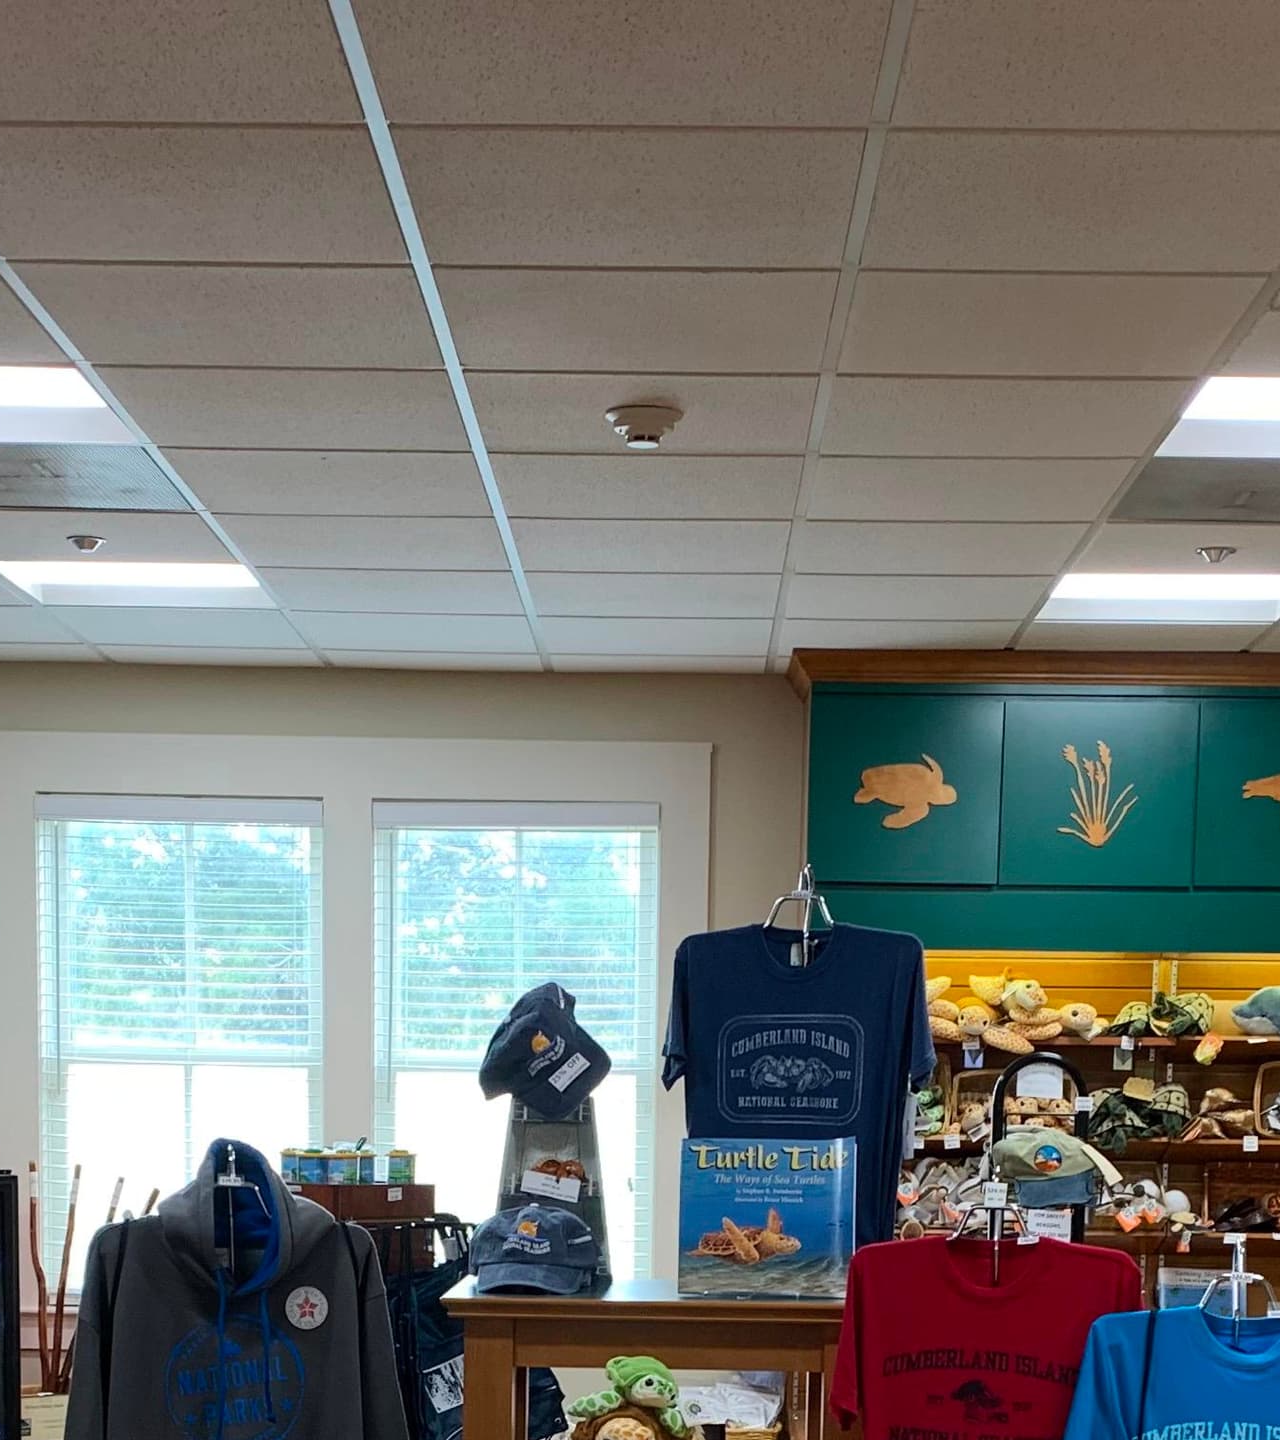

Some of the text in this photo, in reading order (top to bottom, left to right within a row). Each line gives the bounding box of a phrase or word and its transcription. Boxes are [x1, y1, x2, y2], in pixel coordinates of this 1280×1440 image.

[731, 1028, 851, 1059] CUMBERLAND ISLAND
[738, 1096, 786, 1107] NATIONAL
[690, 1144, 850, 1171] Turtle Tide
[714, 1173, 827, 1186] The Ways of Sea Turtles
[177, 1355, 289, 1396] NATONL
[883, 1349, 1009, 1378] CUMBERLAND
[202, 1398, 270, 1427] PARK
